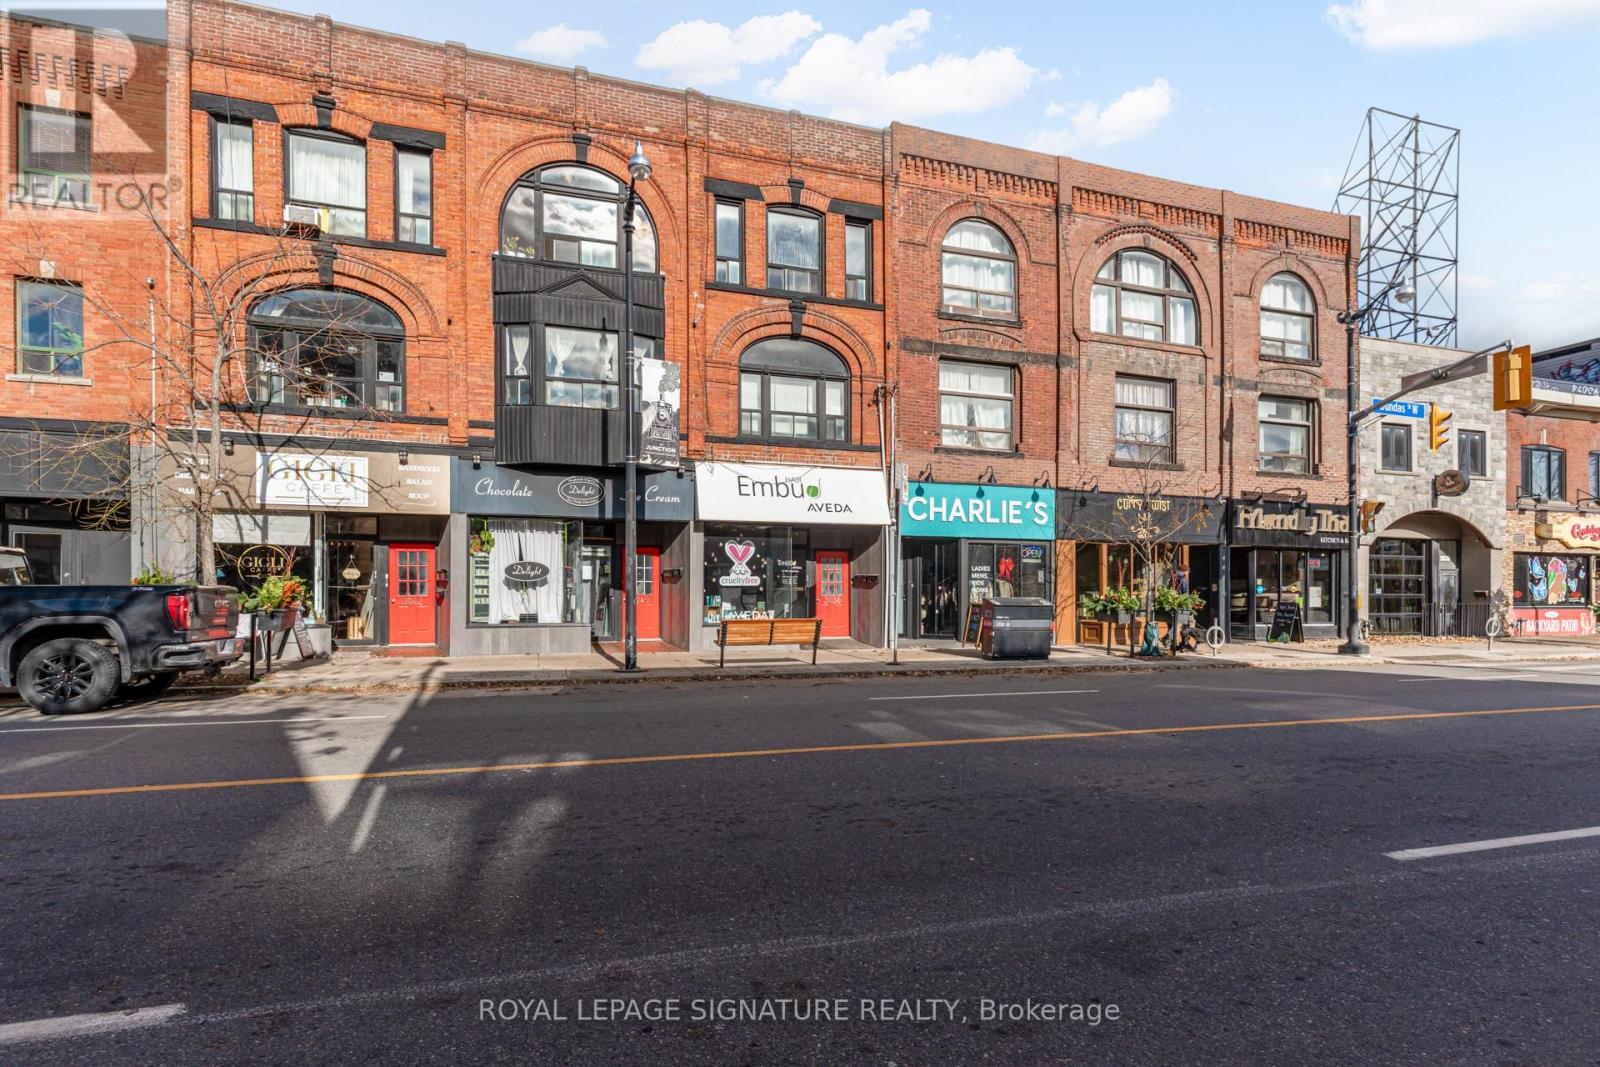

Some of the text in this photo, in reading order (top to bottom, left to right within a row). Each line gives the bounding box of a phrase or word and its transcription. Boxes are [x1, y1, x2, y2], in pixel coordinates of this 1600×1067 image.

[1412, 405, 1418, 415] W
[646, 445, 676, 453] JUNCTION
[268, 459, 357, 484] GIGLI
[286, 483, 344, 495] CAFFE
[475, 477, 533, 497] Chocolate
[568, 485, 596, 497] Delight
[645, 485, 681, 503] Cream
[807, 503, 852, 513] AVEDA
[908, 497, 1049, 525] CHARLIE'S
[1315, 509, 1350, 532] Tha
[1022, 549, 1041, 558] OPEN
[241, 556, 285, 568] GIGLI
[511, 564, 542, 577] Delight
[721, 576, 759, 585] crueltyfree
[728, 610, 769, 620] AVEDA
[1561, 619, 1579, 632] PATIO
